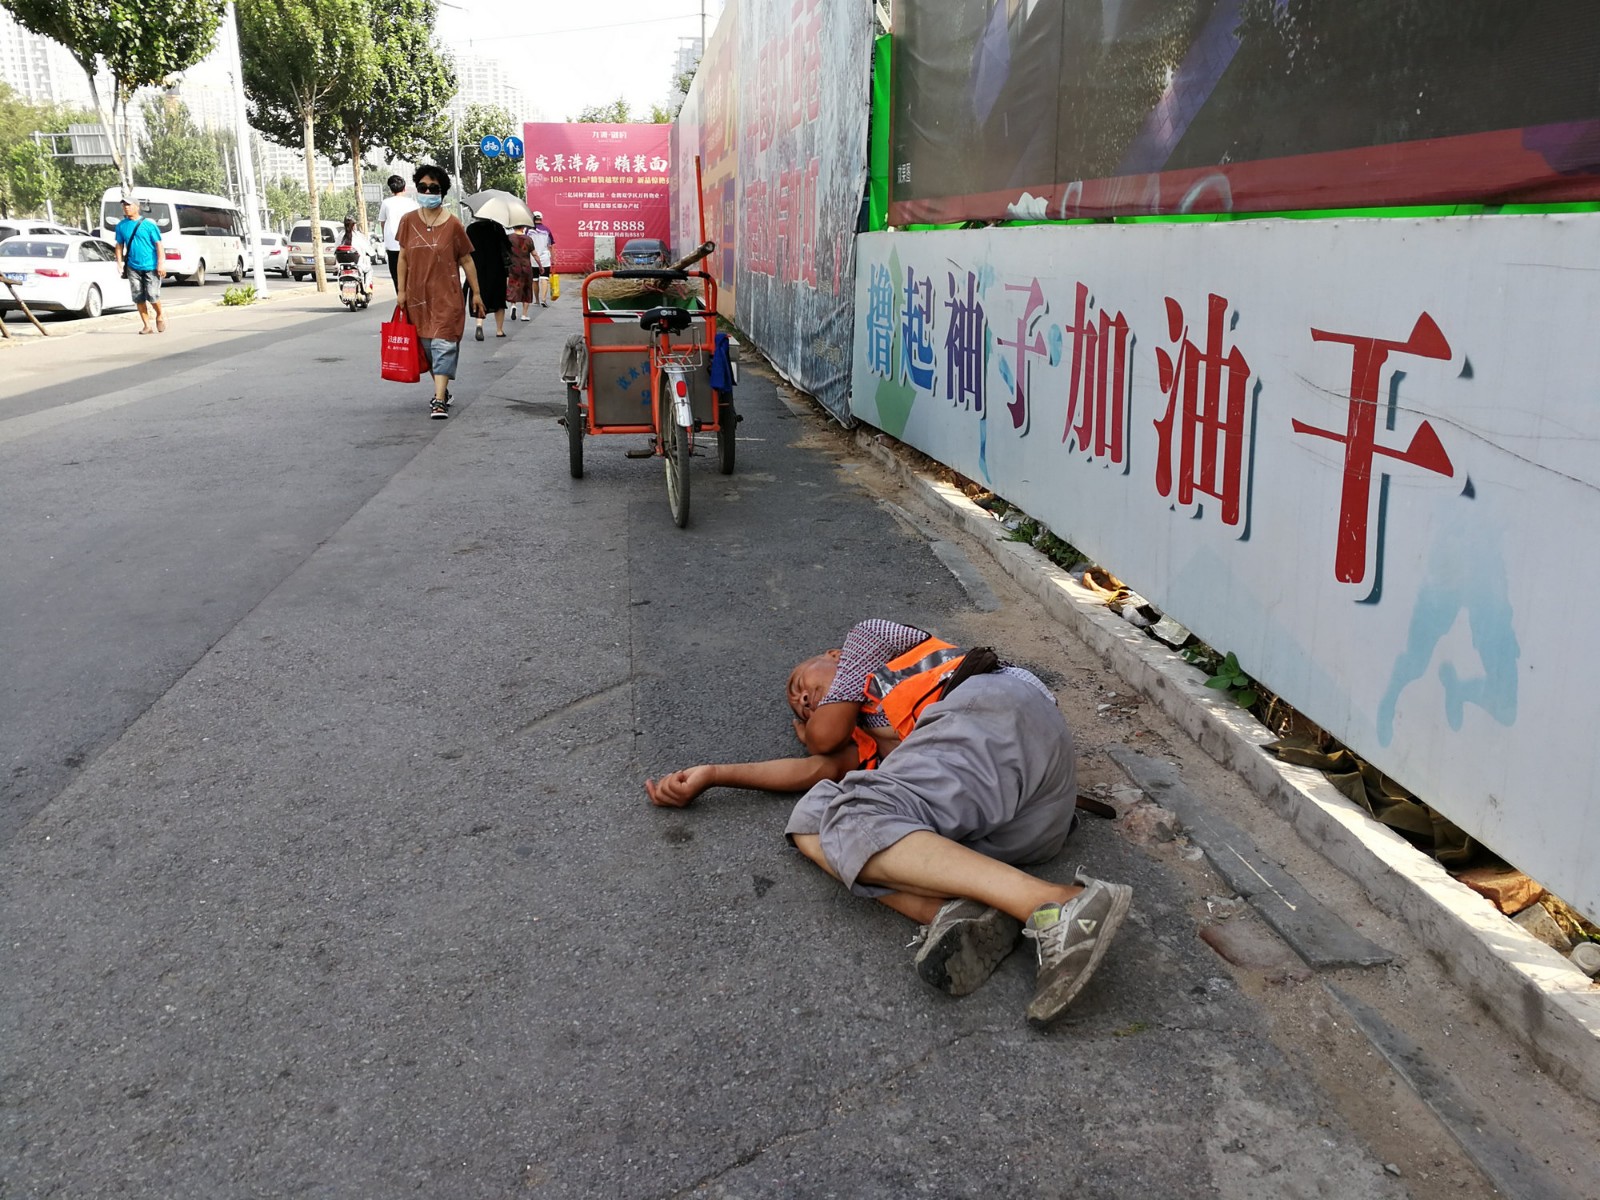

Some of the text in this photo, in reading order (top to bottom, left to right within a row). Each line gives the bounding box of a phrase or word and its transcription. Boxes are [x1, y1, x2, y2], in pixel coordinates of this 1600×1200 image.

[535, 153, 600, 172] 实景洋房
[614, 153, 668, 173] 精装面
[578, 220, 645, 231] 2478 8888
[866, 262, 1454, 585] 撸起袖子加油干
